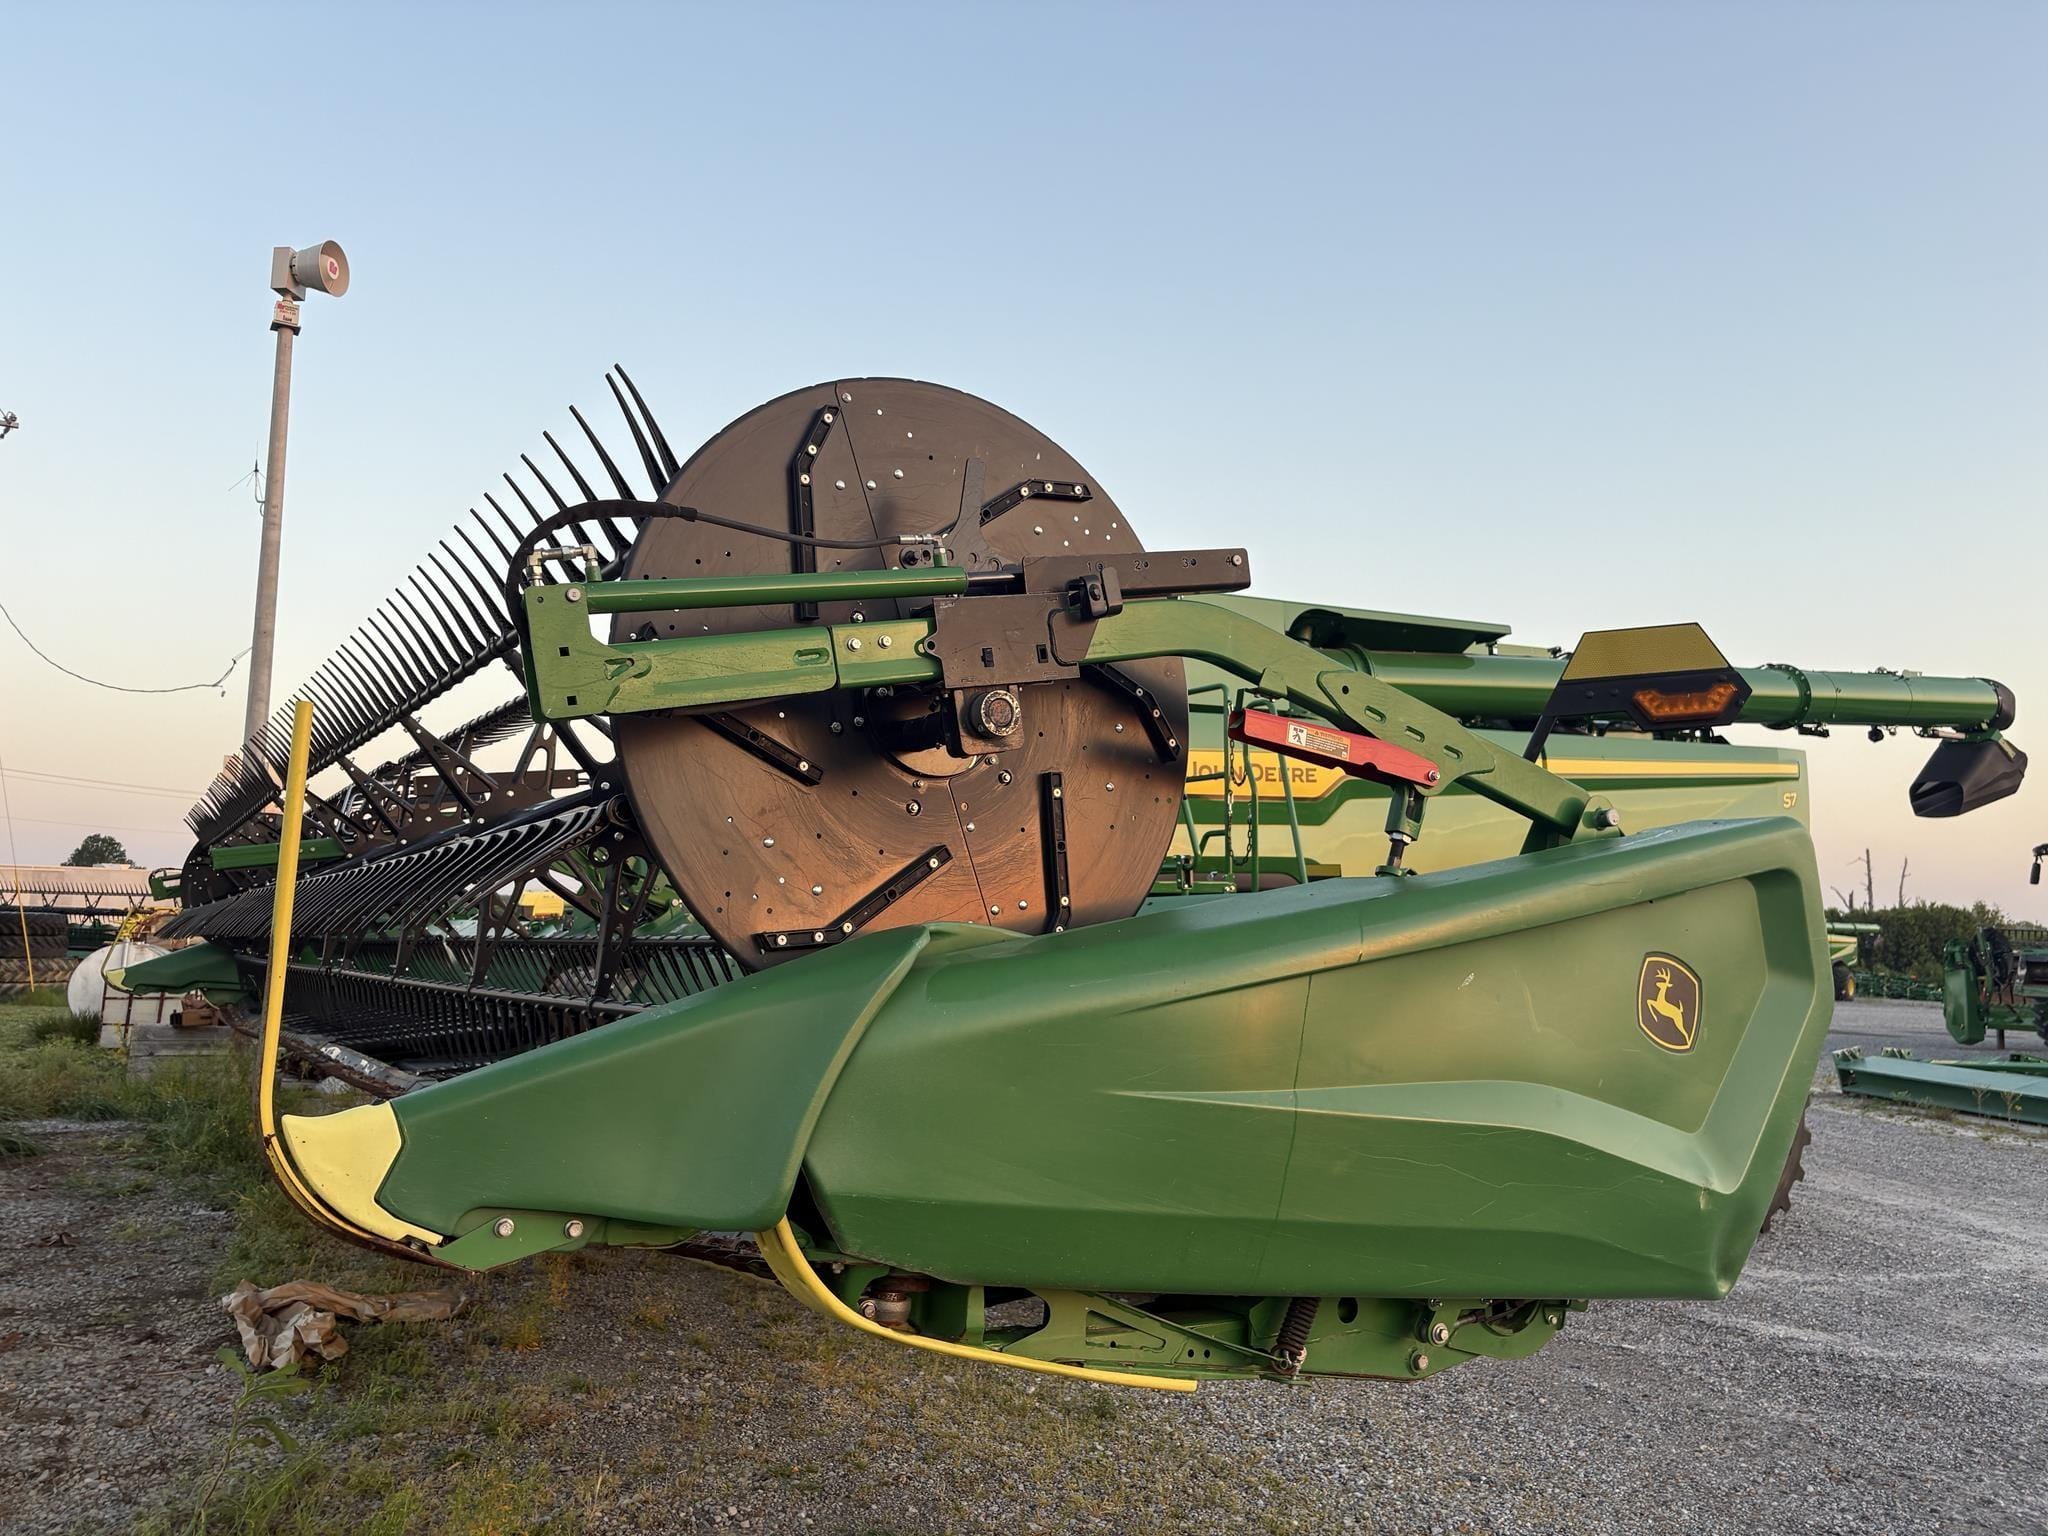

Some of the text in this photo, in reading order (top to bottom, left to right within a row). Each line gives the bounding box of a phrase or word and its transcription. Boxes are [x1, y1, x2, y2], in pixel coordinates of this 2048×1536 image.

[1134, 559, 1141, 570] 2
[1182, 558, 1189, 568] 3
[1783, 791, 1797, 808] S7
